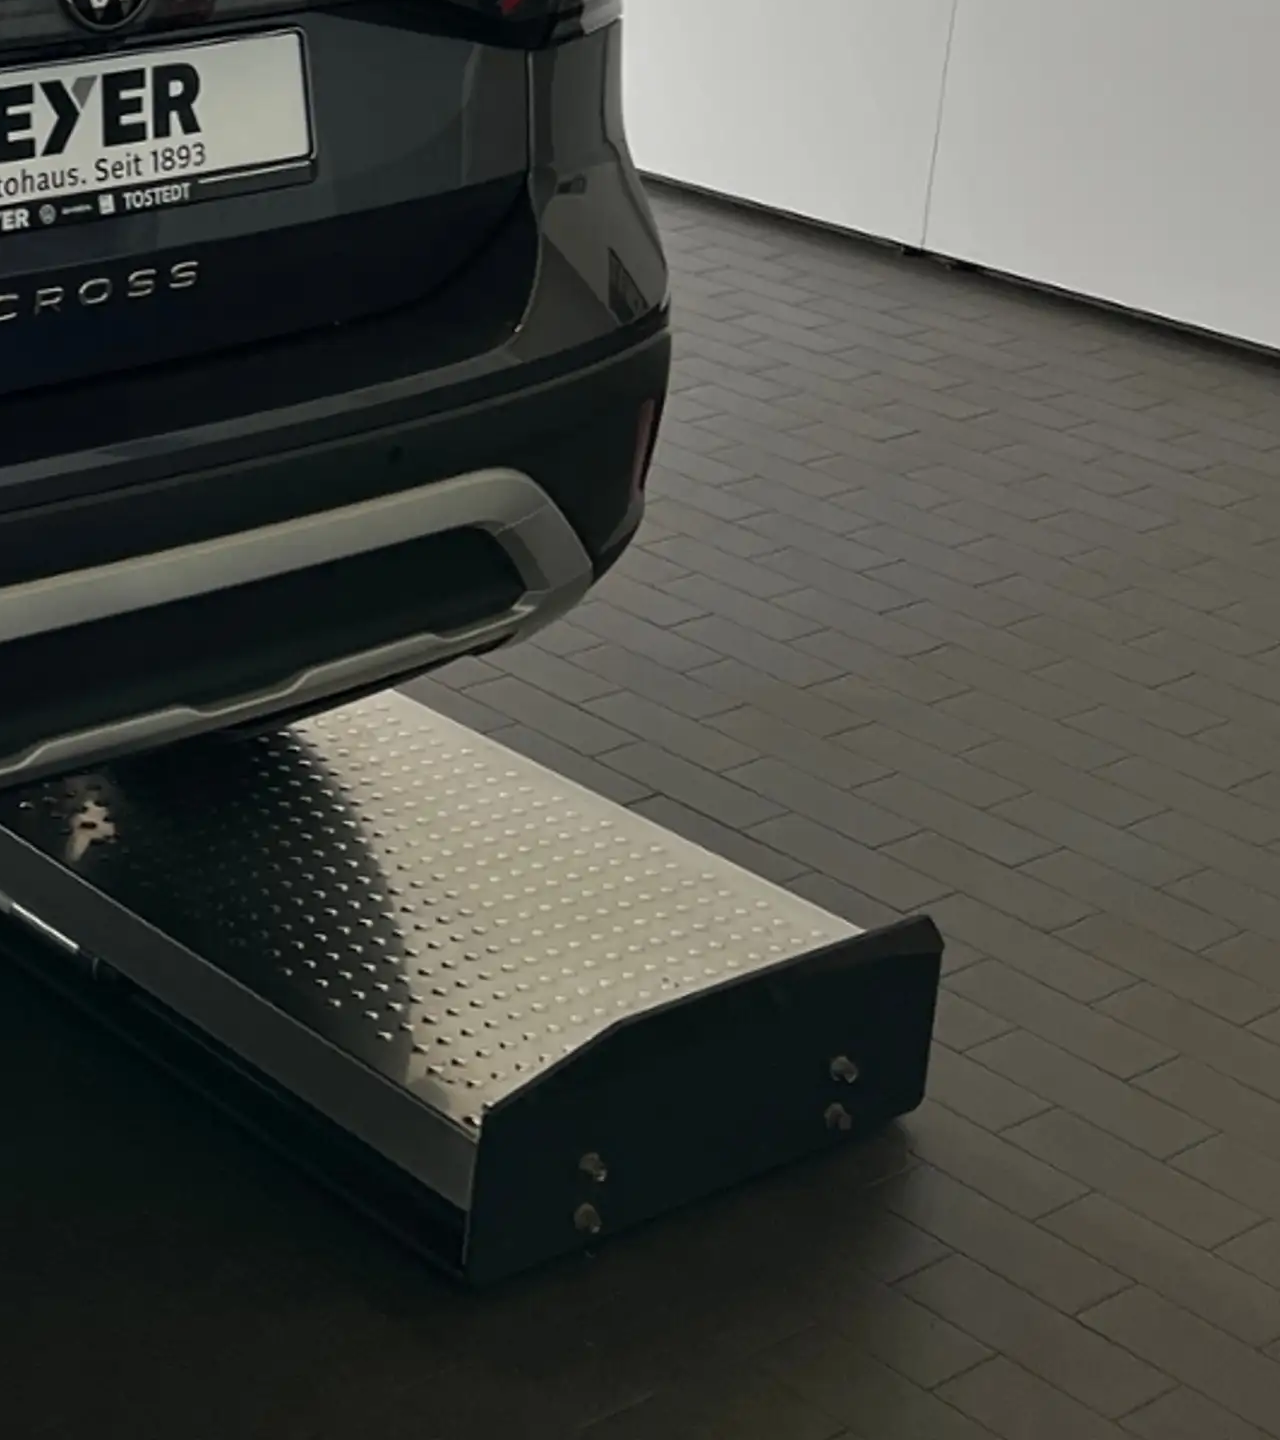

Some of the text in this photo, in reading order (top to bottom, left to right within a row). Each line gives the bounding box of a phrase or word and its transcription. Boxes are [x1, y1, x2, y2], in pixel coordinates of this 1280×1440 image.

[94, 152, 143, 182] Seit
[151, 142, 206, 173] 1893
[122, 181, 191, 211] TOSTEDT
